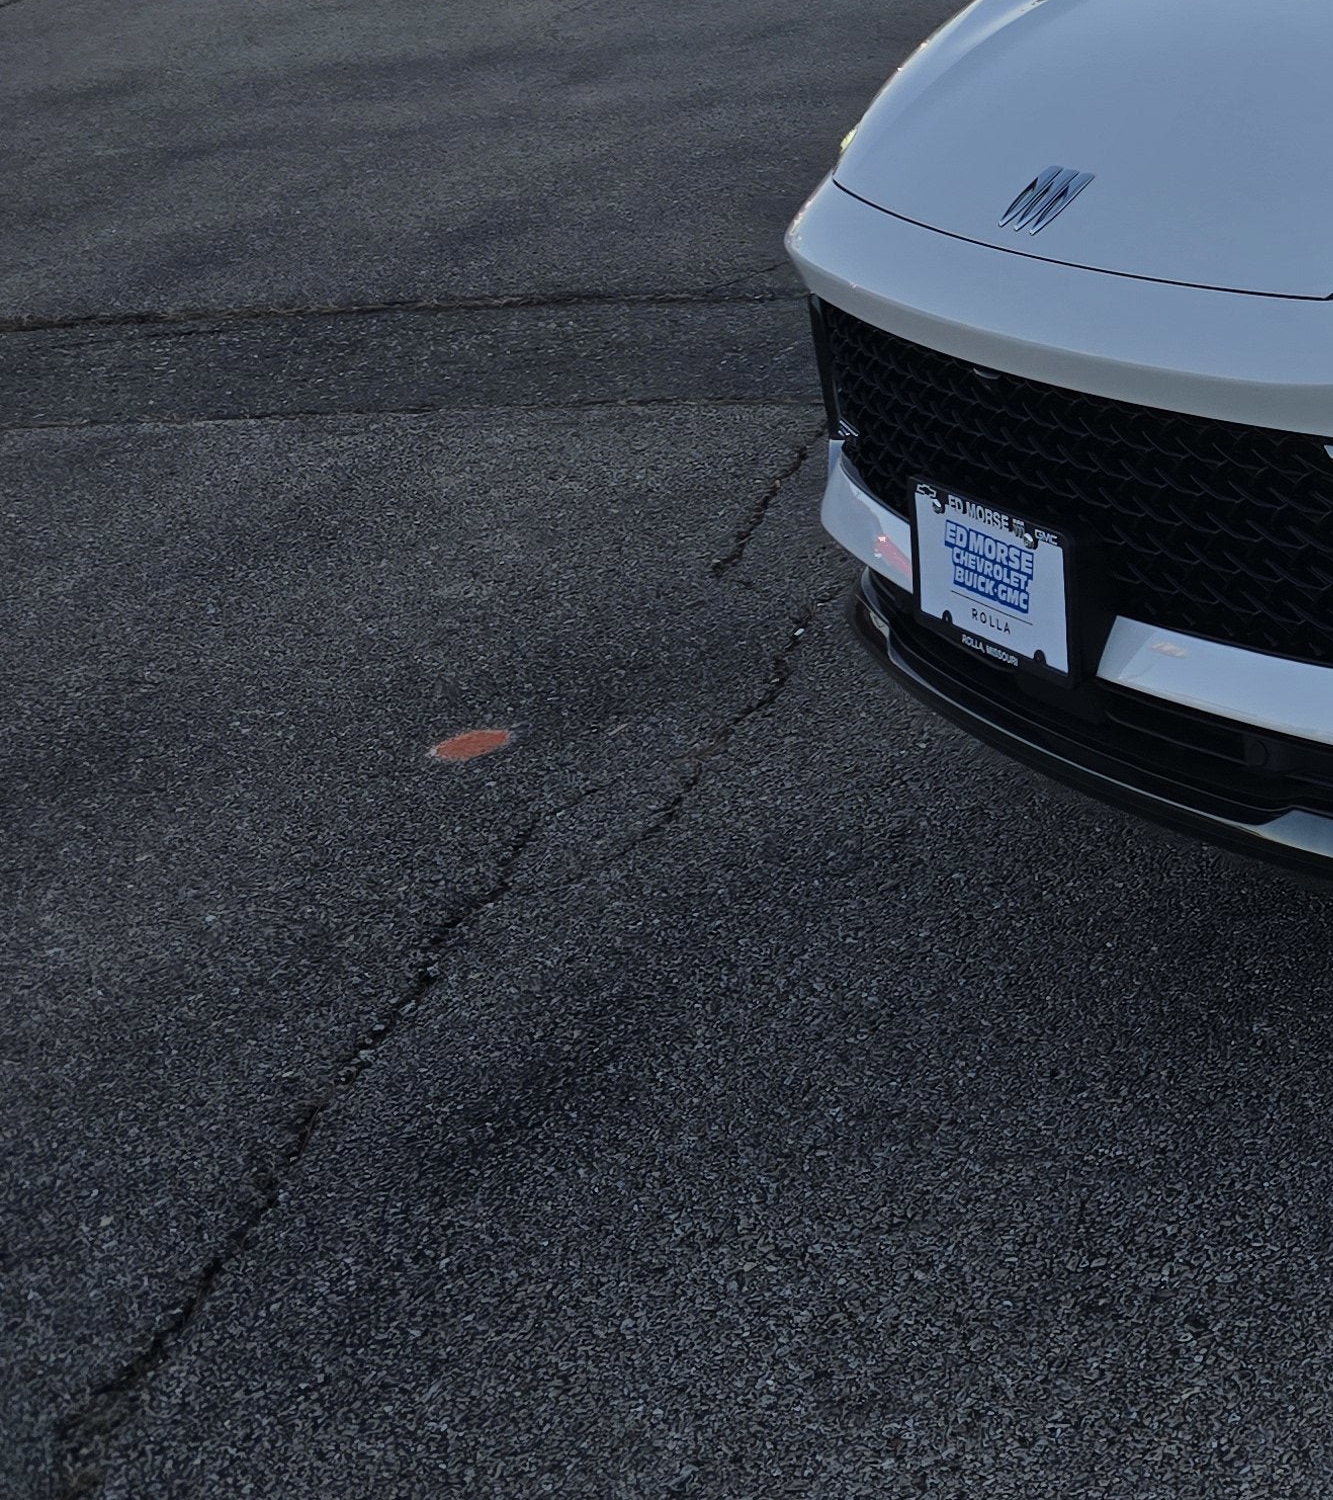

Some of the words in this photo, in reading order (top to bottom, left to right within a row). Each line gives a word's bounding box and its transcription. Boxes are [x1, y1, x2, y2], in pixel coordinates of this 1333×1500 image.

[948, 495, 963, 514] ED
[966, 501, 1010, 531] MORSE
[1034, 529, 1058, 546] GMC
[946, 522, 968, 549] ED
[969, 529, 1033, 574] MORSE
[971, 608, 1012, 635] ROLLA
